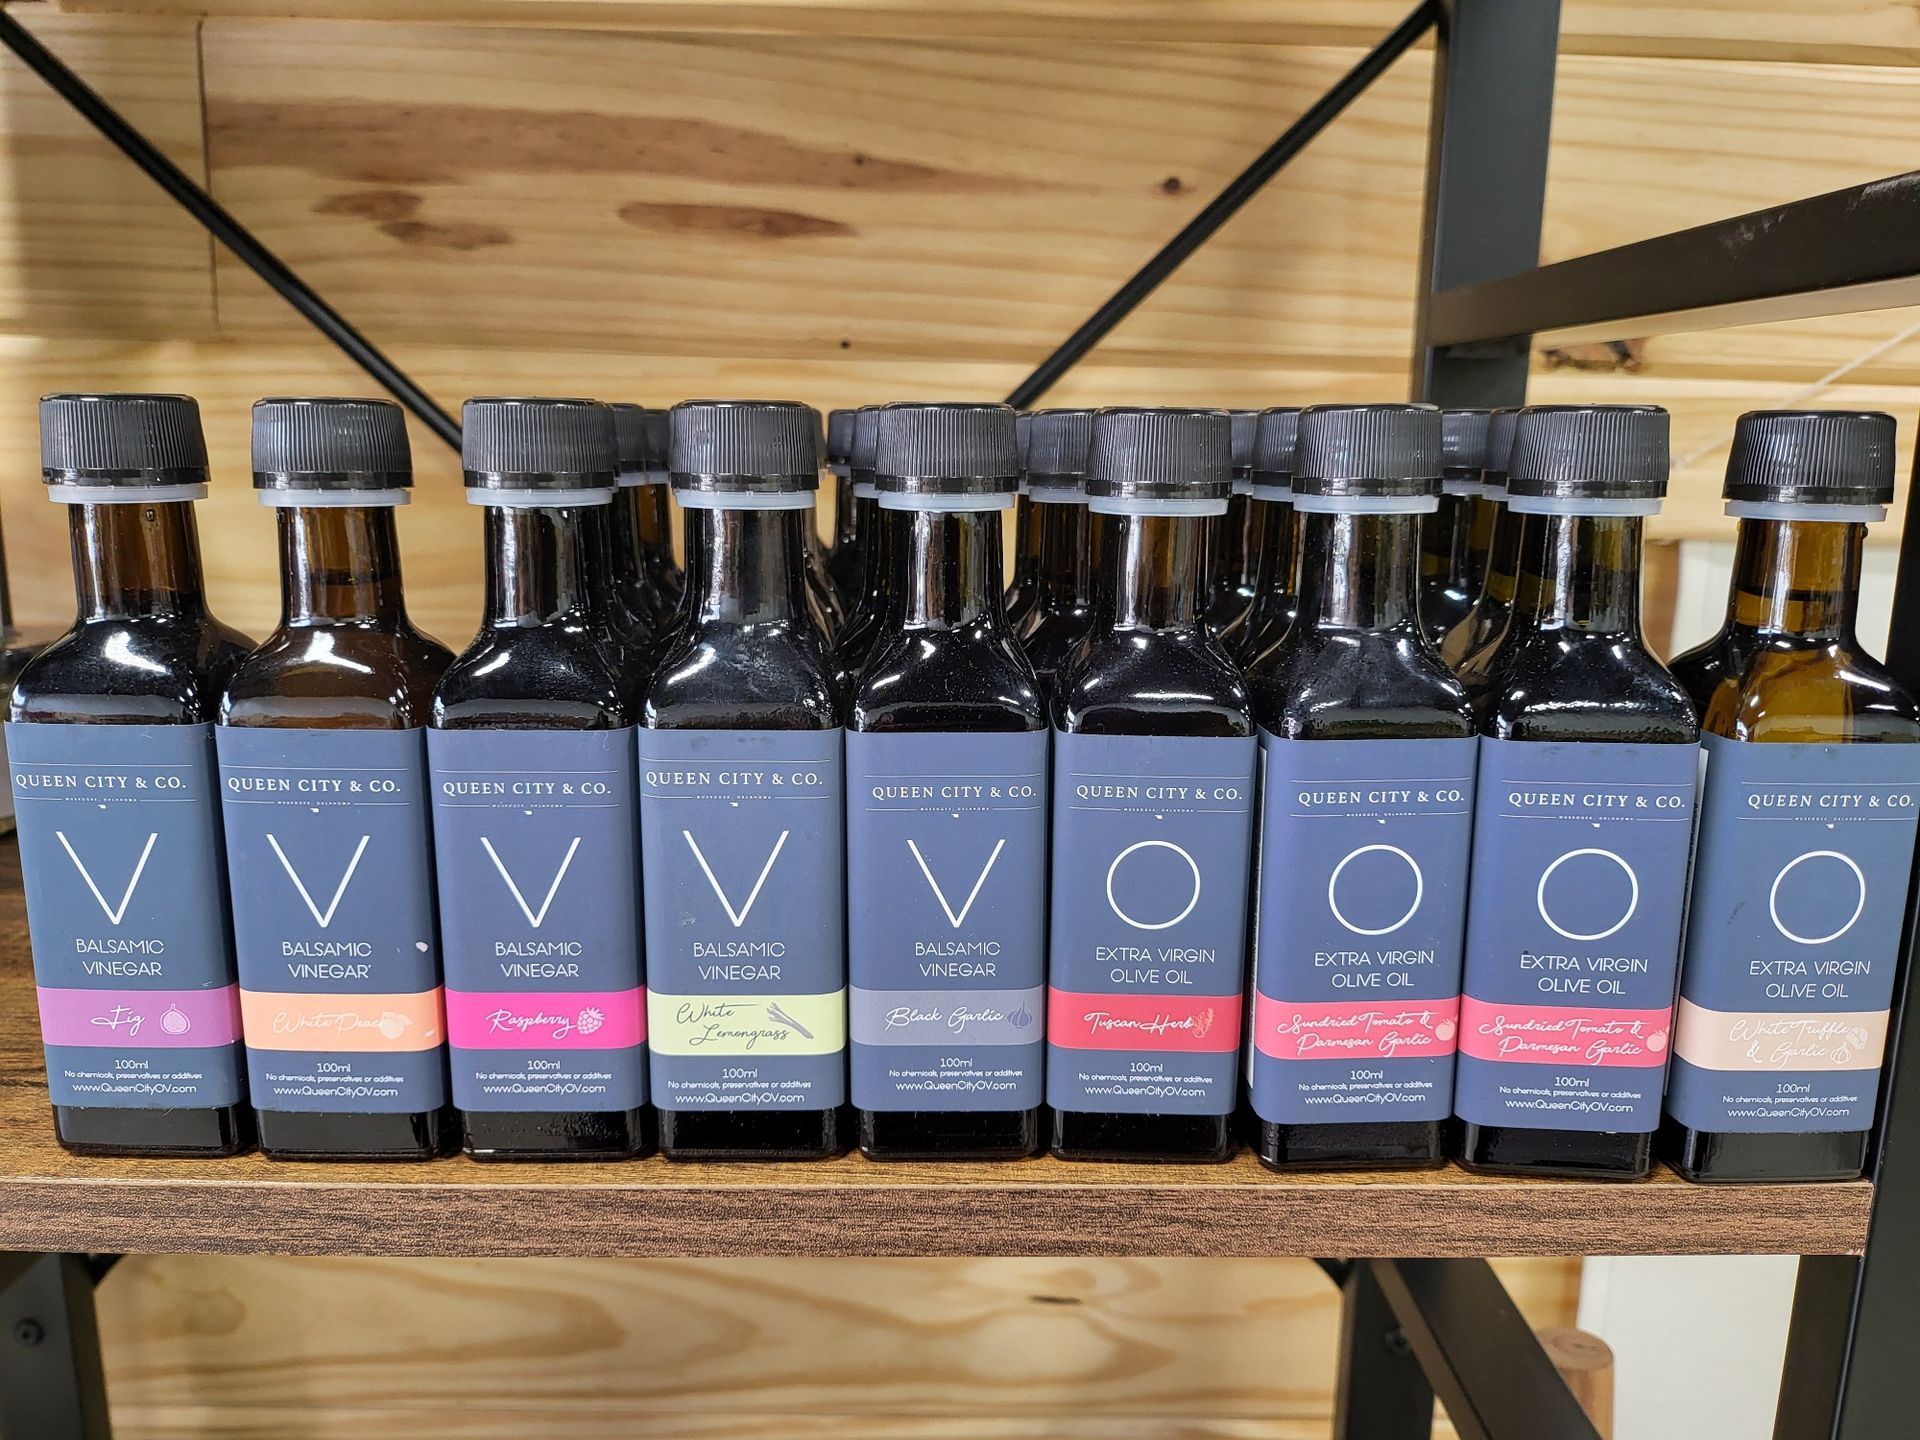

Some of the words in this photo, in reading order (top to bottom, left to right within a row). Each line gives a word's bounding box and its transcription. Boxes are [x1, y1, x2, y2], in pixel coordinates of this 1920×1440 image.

[15, 774, 77, 790] QUEEN
[84, 775, 128, 789] CITY
[135, 777, 148, 789] &
[154, 776, 187, 789] CO.
[227, 777, 290, 793] QUEEN
[297, 779, 342, 792] CITY
[350, 780, 362, 792] &
[369, 779, 401, 793] CO.
[646, 771, 711, 787] QUEEN
[718, 772, 764, 785] CITY
[772, 773, 784, 785] &
[791, 772, 823, 786] CO.
[442, 781, 505, 797] QUEEN
[512, 782, 556, 795] CITY
[562, 782, 575, 795] &
[580, 782, 612, 795] CO.
[872, 786, 934, 800] QUEEN
[941, 786, 983, 798] CITY
[990, 786, 1002, 798] &
[1008, 785, 1037, 798] CO.
[1076, 784, 1139, 800] QUEEN
[1145, 787, 1189, 800] CITY
[1195, 788, 1207, 800] &
[1213, 787, 1242, 800] CO.
[1298, 791, 1361, 806] QUEEN
[1368, 790, 1411, 804] CITY
[1417, 790, 1430, 803] &
[1435, 789, 1465, 802] CO.
[1508, 792, 1576, 808] QUEEN
[1582, 794, 1629, 807] CITY
[1635, 796, 1648, 808] &
[1655, 795, 1685, 808] CO.
[1747, 794, 1813, 810] QUEEN
[1819, 794, 1863, 808] CITY
[1868, 795, 1880, 808] &
[1887, 794, 1915, 808] CO.
[56, 832, 157, 924] V
[267, 834, 370, 927] V
[481, 837, 581, 927] V
[683, 831, 789, 927] V
[907, 839, 1005, 927] V
[1107, 841, 1200, 929] O
[1329, 845, 1423, 935] O
[1538, 849, 1638, 940] O
[1770, 851, 1865, 944] O
[75, 938, 165, 955] BALSAMIC
[281, 941, 372, 957] BALSAMIC
[495, 941, 583, 957] BALSAMIC
[693, 942, 786, 958] BALSAMIC
[915, 941, 1001, 956] BALSAMIC
[1095, 946, 1153, 962] EXTRA
[1157, 947, 1215, 963] VIRGIN
[1314, 951, 1372, 967] EXTRA
[1376, 950, 1434, 965] VIRGIN
[1520, 954, 1581, 971] EXTRA
[1586, 957, 1648, 973] VIRGIN
[82, 960, 163, 976] VINEGAR
[287, 963, 369, 979] VINEGAR
[500, 963, 580, 978] VINEGAR
[698, 965, 781, 981] VINEGAR
[919, 962, 996, 977] VINEGAR
[1749, 960, 1808, 976] EXTRA
[1813, 960, 1871, 976] VIRGIN
[1110, 968, 1160, 984] OLIVE
[1165, 969, 1193, 985] OIL
[1331, 972, 1382, 988] OLIVE
[1386, 972, 1415, 987] OIL
[1537, 977, 1592, 994] OLIVE
[1596, 979, 1626, 995] OIL
[1765, 983, 1817, 998] OLIVE
[1821, 983, 1849, 998] OIL
[90, 1004, 146, 1036] Fig
[676, 1002, 757, 1026] White
[884, 1006, 943, 1031] Black
[947, 1006, 1005, 1034] Garlic
[272, 1011, 334, 1034] White
[485, 1008, 577, 1040] Raspberry
[1083, 1012, 1141, 1034] Tuscan
[1140, 1014, 1195, 1036] Herb
[1276, 1014, 1359, 1036] Sundried
[1358, 1011, 1419, 1030] Tomato
[1478, 1016, 1565, 1037] Sundried
[1559, 1018, 1624, 1037] Tomato
[1728, 1018, 1797, 1043] White
[1792, 1019, 1852, 1043] Truffle
[688, 1023, 792, 1050] Lemongrass
[1295, 1032, 1373, 1056] Parmesan
[1378, 1031, 1433, 1058] Garlic
[1498, 1035, 1581, 1058] Parmesan
[1585, 1040, 1643, 1067] Garlic
[1768, 1039, 1828, 1070] Garlic
[114, 1059, 149, 1070] 100ml
[316, 1062, 351, 1073] 100ml
[527, 1059, 561, 1071] 100ml
[940, 1057, 973, 1068] 100ml
[1130, 1062, 1163, 1073] 100ml
[64, 1070, 76, 1078] No
[265, 1073, 278, 1081] No
[475, 1072, 488, 1080] No
[722, 1067, 758, 1079] 100ml
[888, 1069, 901, 1077] No
[1078, 1072, 1090, 1081] No
[1350, 1069, 1384, 1080] 100ml
[72, 1082, 197, 1096] www.QueenCityOV.com
[483, 1082, 606, 1096] www.QueenCityOV.com
[667, 1080, 680, 1089] No
[895, 1080, 1017, 1093] www.QueenCityOV.com
[1499, 1086, 1512, 1094] No
[1554, 1076, 1590, 1088] 100ml
[1776, 1083, 1811, 1094] 100ml
[273, 1085, 399, 1099] www.QueenCityOV.com
[675, 1092, 805, 1106] www.QueenCityOV.com
[1084, 1084, 1206, 1099] www.QueenCityOV.com
[1304, 1092, 1426, 1105] www.QueenCityOV.com
[1504, 1098, 1634, 1114] www.QueenCityOV.com
[1727, 1107, 1850, 1120] www.QueenCityOV.com
